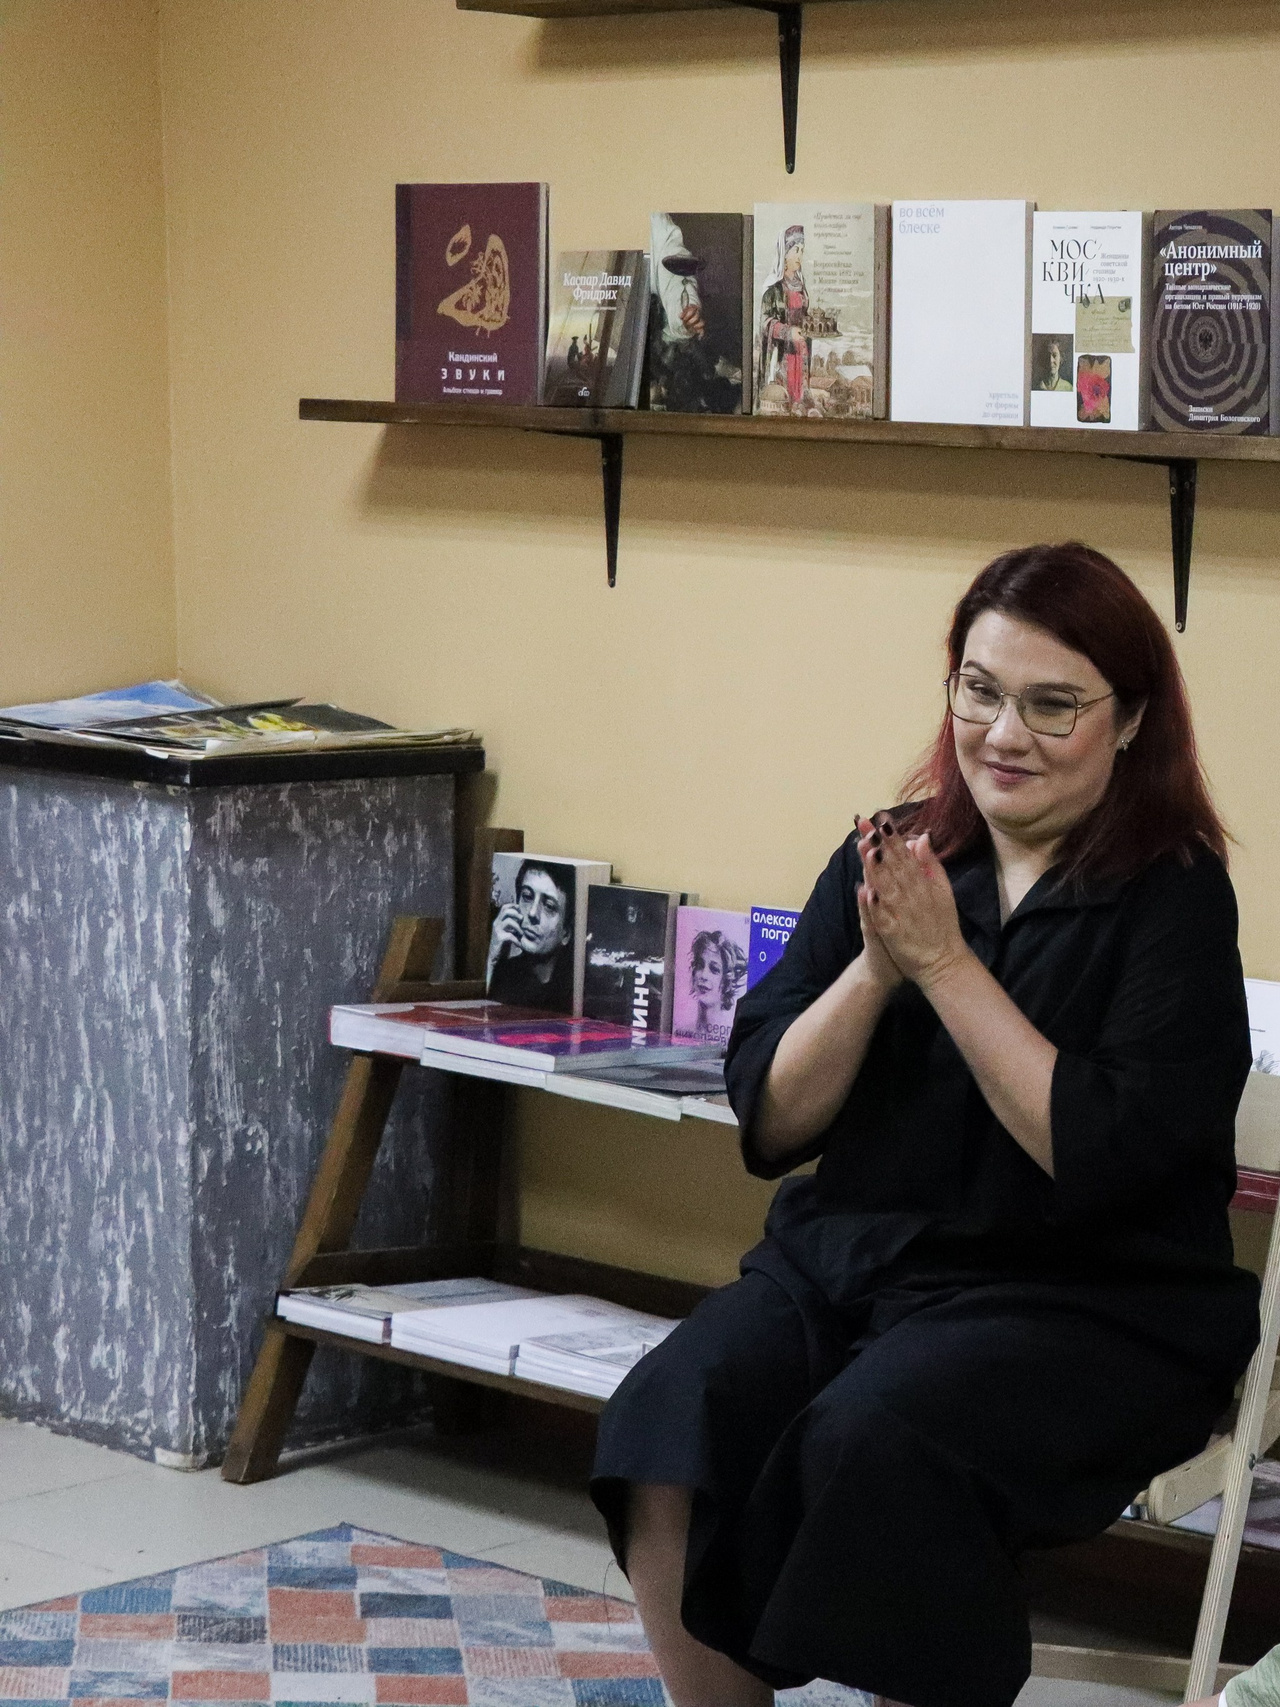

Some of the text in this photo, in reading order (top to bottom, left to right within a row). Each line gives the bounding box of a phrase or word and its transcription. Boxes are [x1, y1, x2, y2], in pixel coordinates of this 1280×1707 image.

[899, 204, 945, 218] во всём
[898, 220, 941, 234] блеске
[1159, 240, 1263, 259] «Анонимный
[563, 272, 632, 290] Каспар Давид
[1164, 262, 1217, 282] центр»
[573, 286, 618, 304] Фридрих
[1064, 283, 1105, 304] ЧКА
[448, 351, 498, 363] Кандинский
[752, 911, 798, 929] алексан
[761, 927, 790, 945] погр
[707, 1023, 731, 1037] серг
